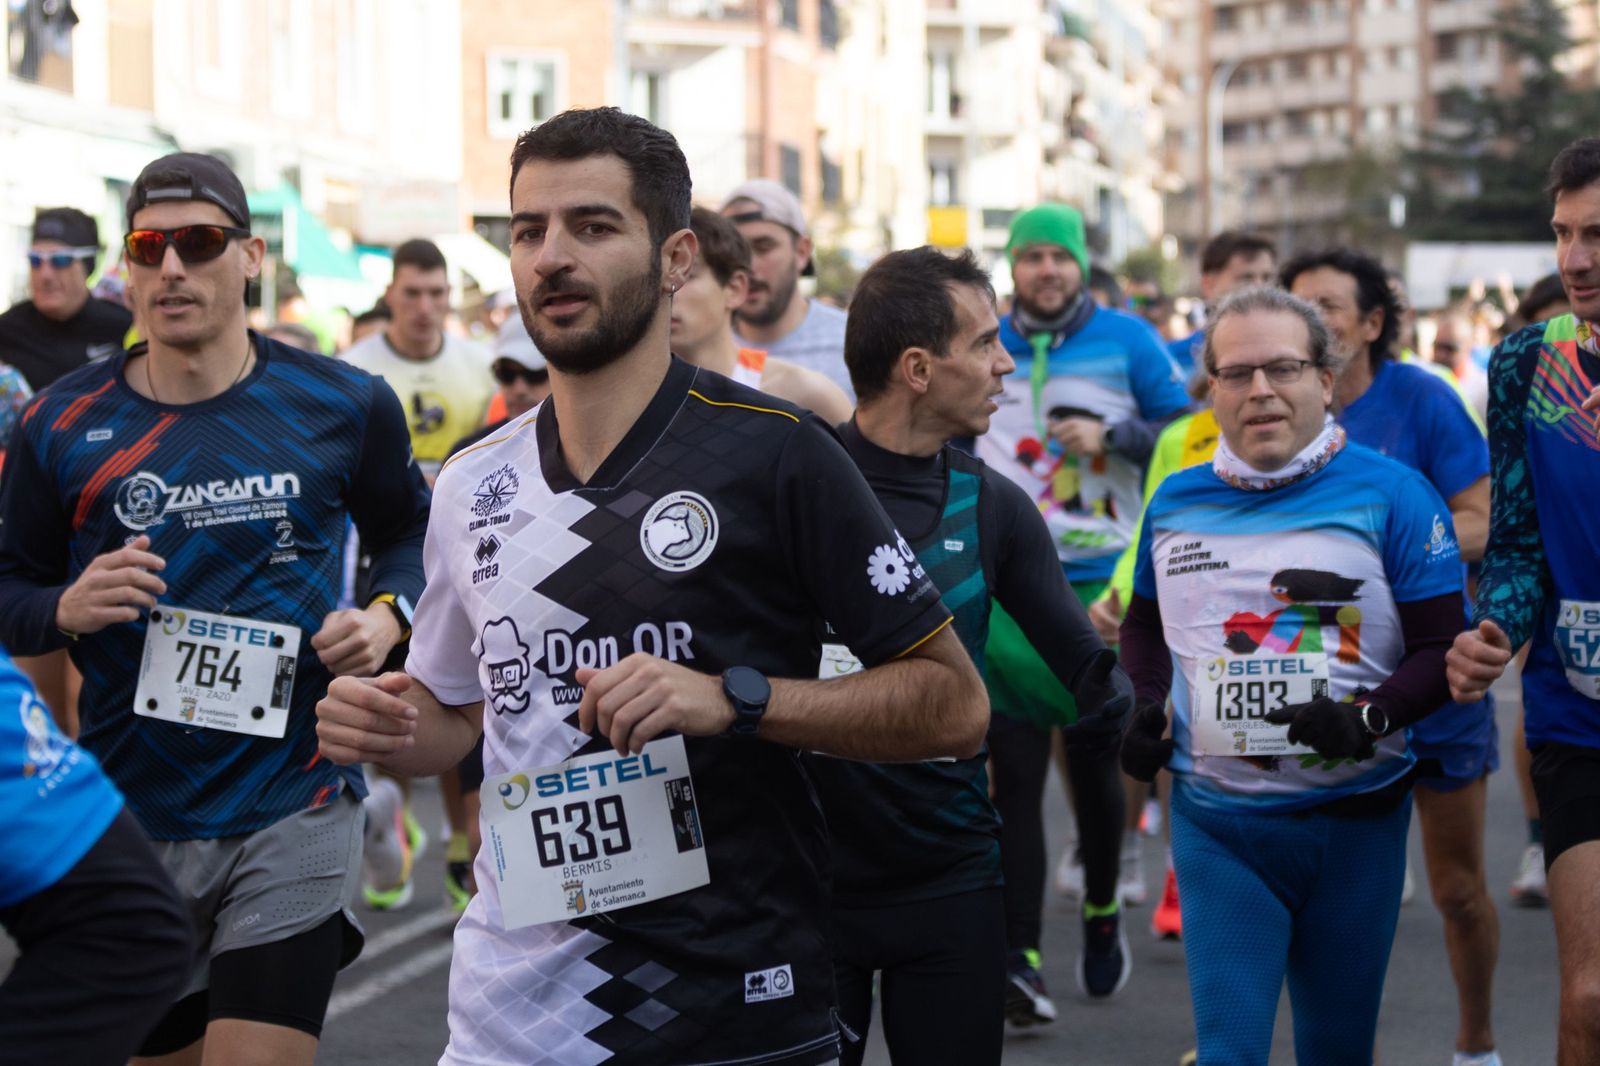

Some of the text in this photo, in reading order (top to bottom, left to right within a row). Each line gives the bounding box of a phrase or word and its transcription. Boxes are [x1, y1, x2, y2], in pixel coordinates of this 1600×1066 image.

[191, 518, 203, 528] de
[204, 513, 248, 526] diciembre
[248, 511, 263, 521] del
[263, 509, 288, 519] 2024
[193, 509, 213, 520] Cross
[213, 507, 229, 518] Trail
[228, 504, 252, 516] Ciudad
[252, 503, 262, 513] de
[262, 501, 288, 511] Zamora
[1183, 541, 1202, 552] SAN
[1168, 551, 1212, 566] SILVESTRE
[472, 563, 499, 585] errea
[1166, 561, 1230, 577] SALMANTINA
[187, 618, 284, 649] SETEL
[546, 630, 619, 675] Don
[176, 640, 242, 692] 764
[1228, 658, 1314, 676] SETEL
[176, 684, 232, 702] JAVI ZAZO
[554, 687, 585, 703] ww
[1216, 681, 1288, 721] 1393
[197, 715, 238, 729] de Salamanca
[199, 706, 239, 720] Ayuntamiento
[1249, 737, 1287, 745] Ayuntamiento
[535, 754, 668, 798] SETEL
[682, 785, 692, 802] 639
[531, 794, 632, 869] 639
[563, 858, 613, 879] BERMIS
[588, 878, 644, 898] Ayuntamiento
[590, 891, 646, 909] de Salamanca
